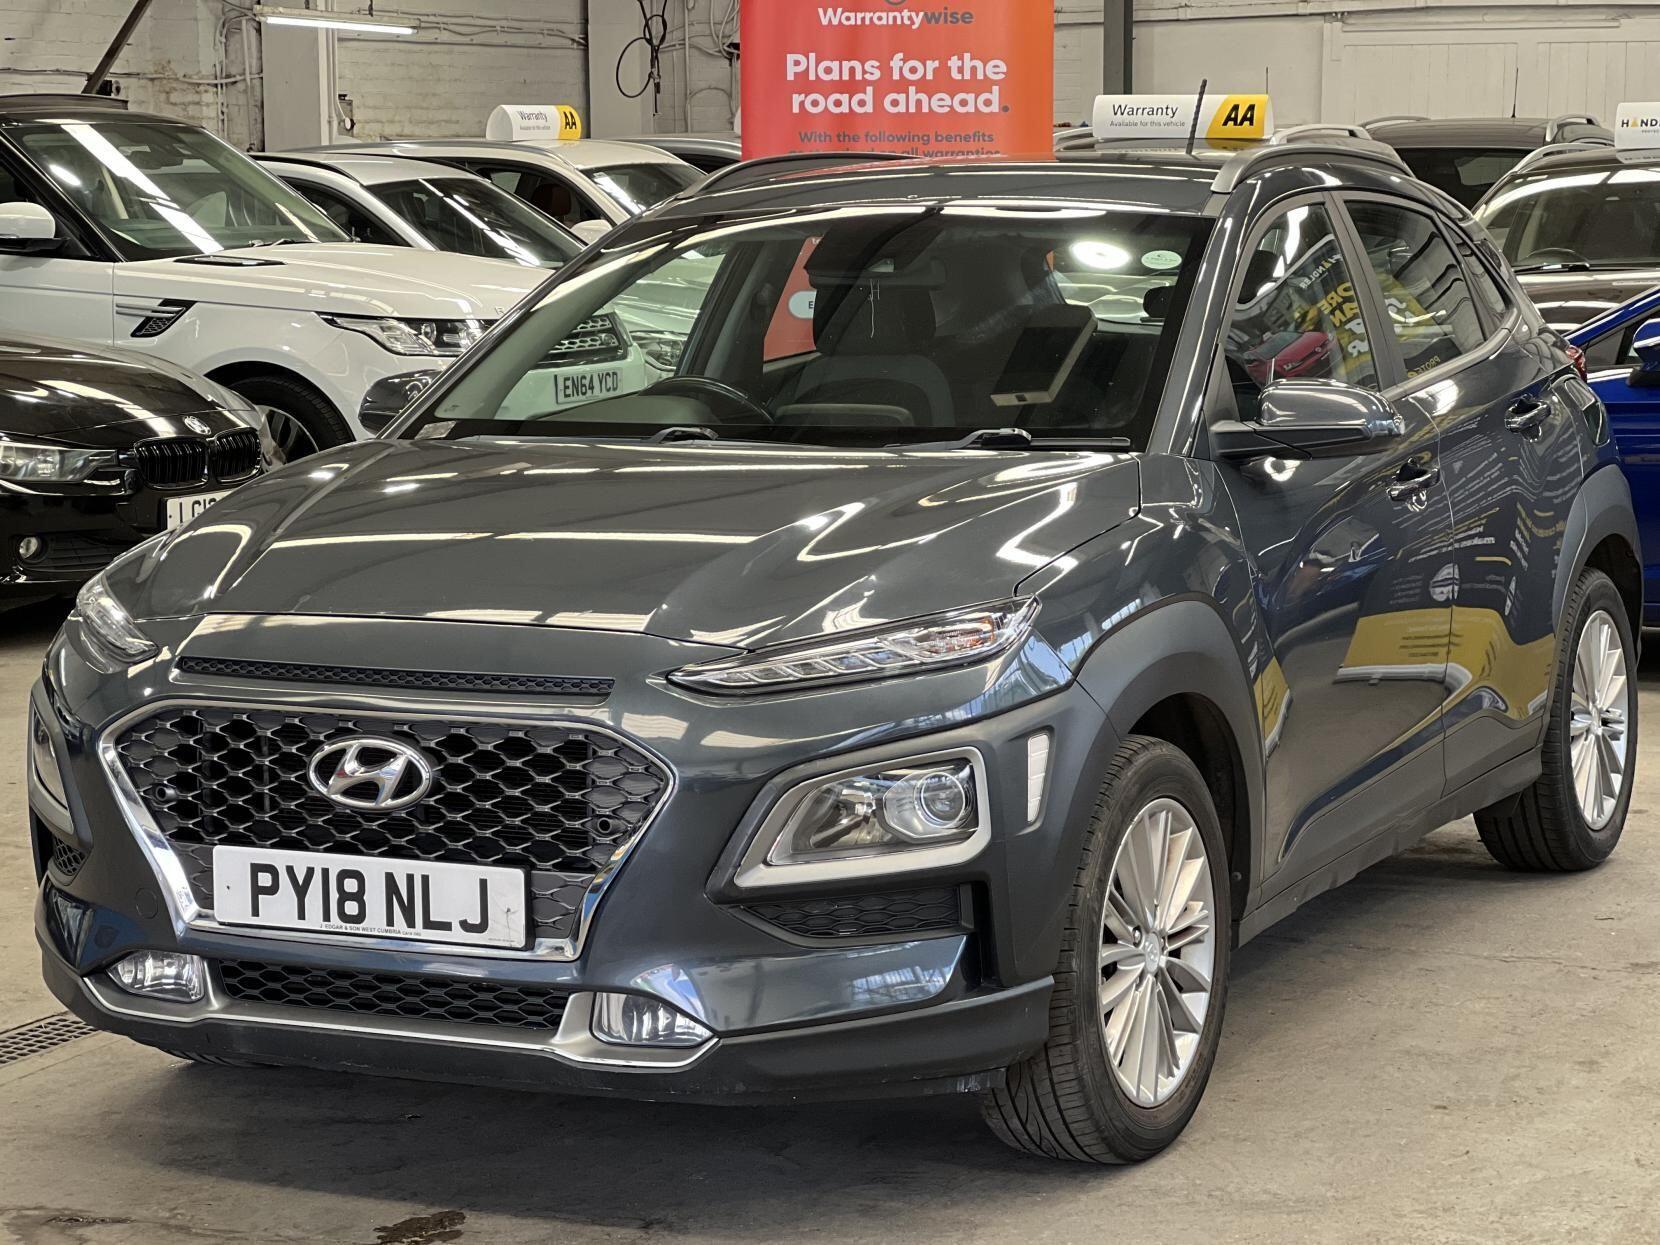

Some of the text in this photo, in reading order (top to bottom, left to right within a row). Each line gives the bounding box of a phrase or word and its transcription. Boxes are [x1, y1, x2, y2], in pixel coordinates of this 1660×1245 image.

[818, 7, 974, 29] Warrantywise
[786, 53, 1007, 81] Plans for the
[792, 86, 1010, 113] road ahead.
[563, 111, 577, 129] AA
[1112, 104, 1179, 118] Warranty
[1222, 104, 1256, 126] AA
[1621, 117, 1660, 128] HAND
[799, 131, 994, 145] With the following benefits
[563, 371, 619, 399] EN64 YCD
[250, 862, 489, 934] PY18 NLJ
